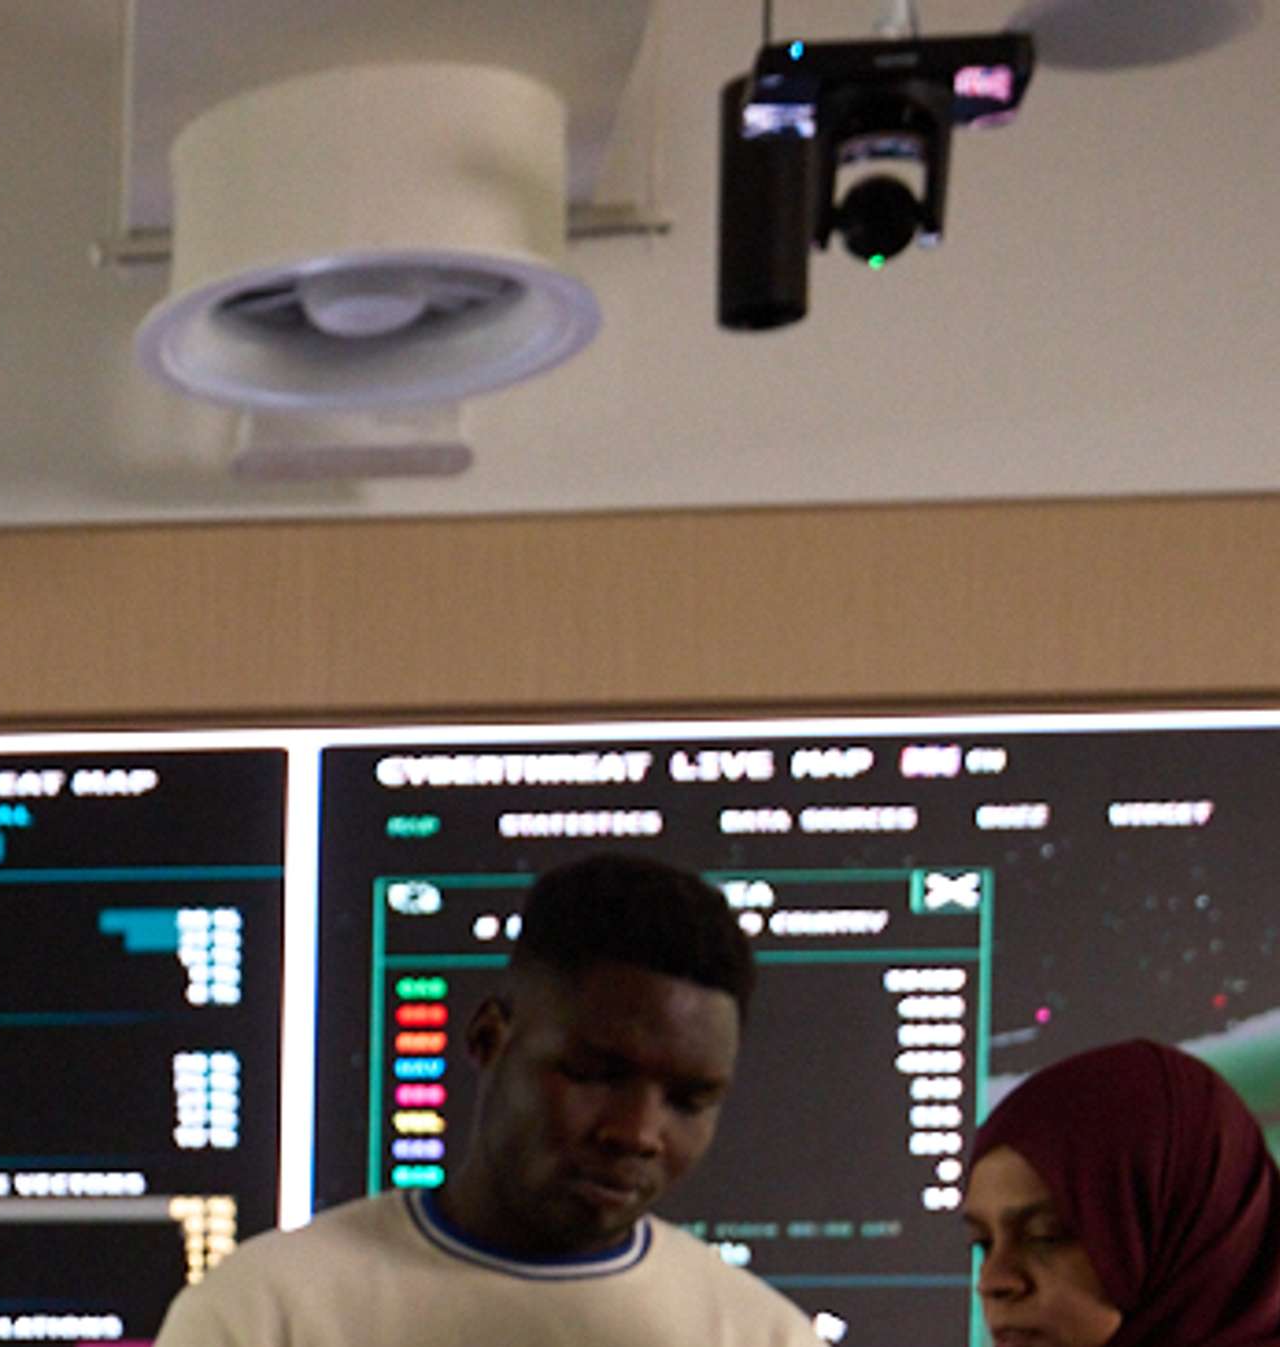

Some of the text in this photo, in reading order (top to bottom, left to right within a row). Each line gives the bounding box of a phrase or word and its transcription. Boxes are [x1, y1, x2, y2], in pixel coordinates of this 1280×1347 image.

[71, 769, 157, 796] MAP
[375, 746, 874, 787] CYBERTHREAT LIVE MAP
